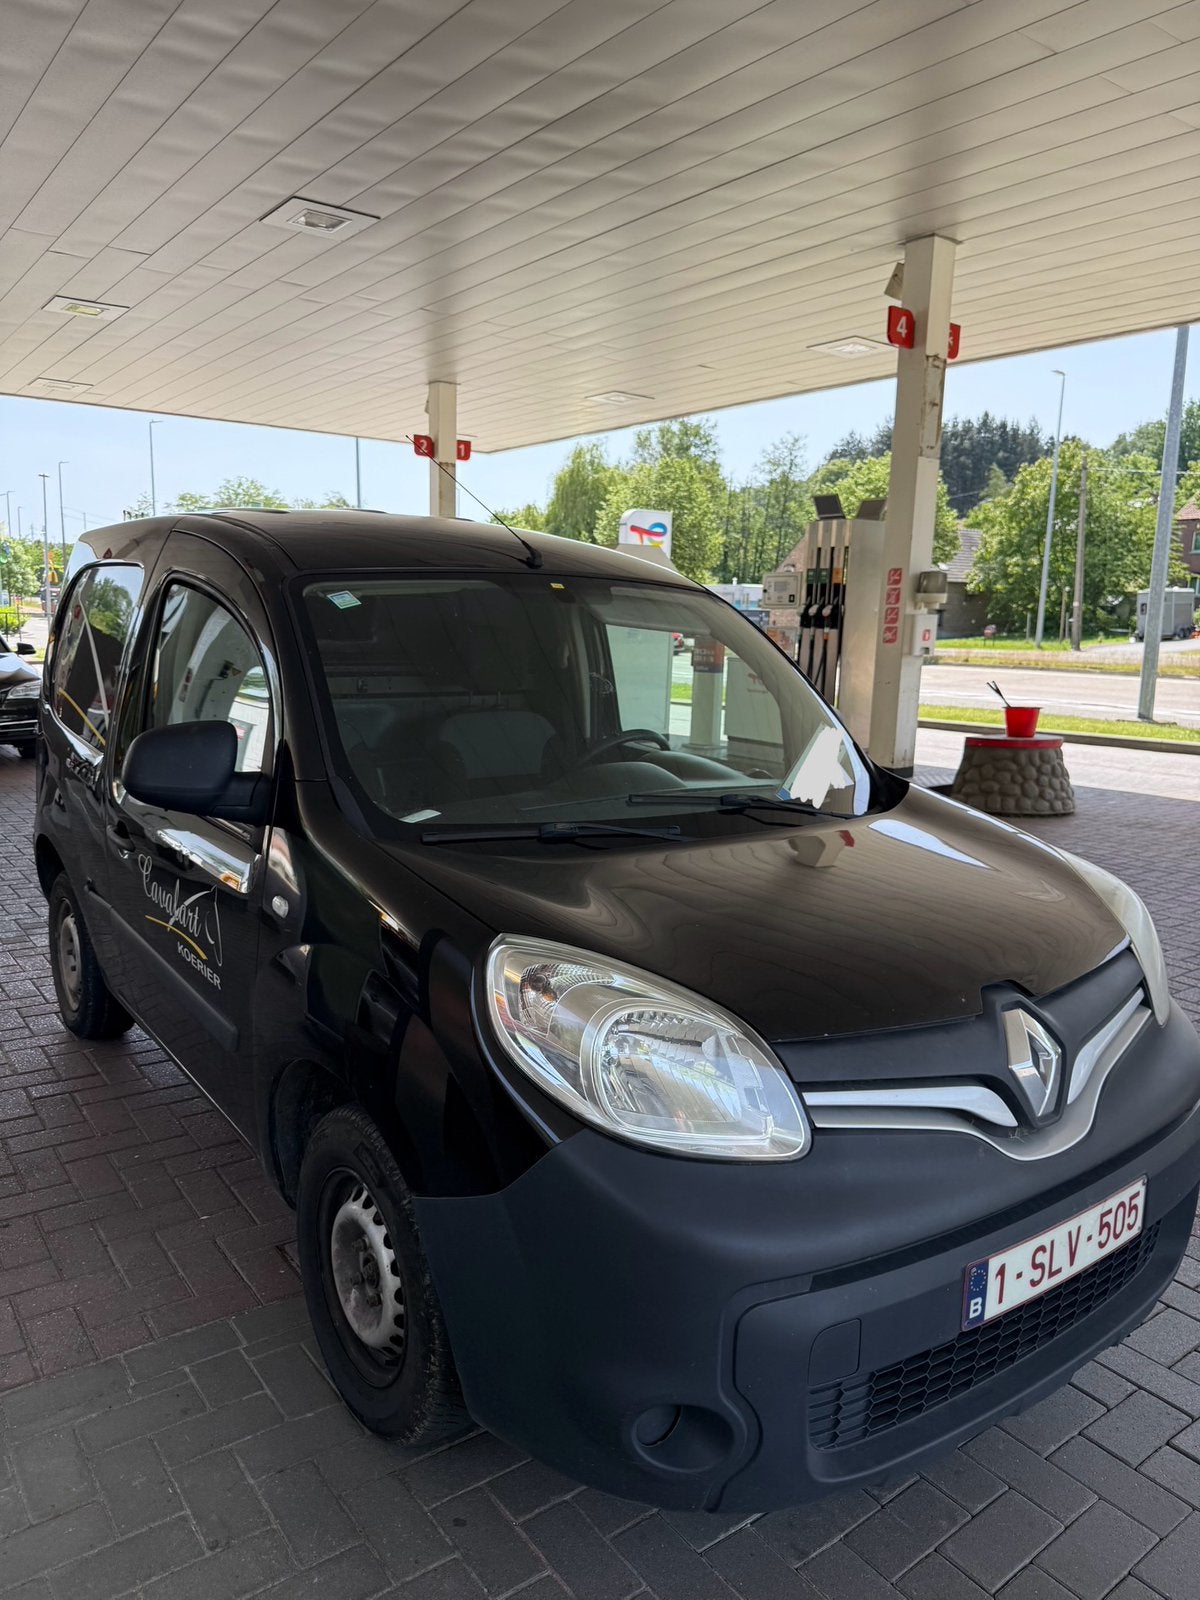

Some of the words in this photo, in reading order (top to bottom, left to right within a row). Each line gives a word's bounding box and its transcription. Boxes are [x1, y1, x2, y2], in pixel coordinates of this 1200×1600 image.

[896, 315, 908, 339] 4
[419, 439, 428, 454] 2
[458, 444, 466, 458] 1
[177, 941, 222, 991] KOERIER
[994, 1190, 1141, 1305] 1-SLV-505
[969, 1296, 983, 1319] B
